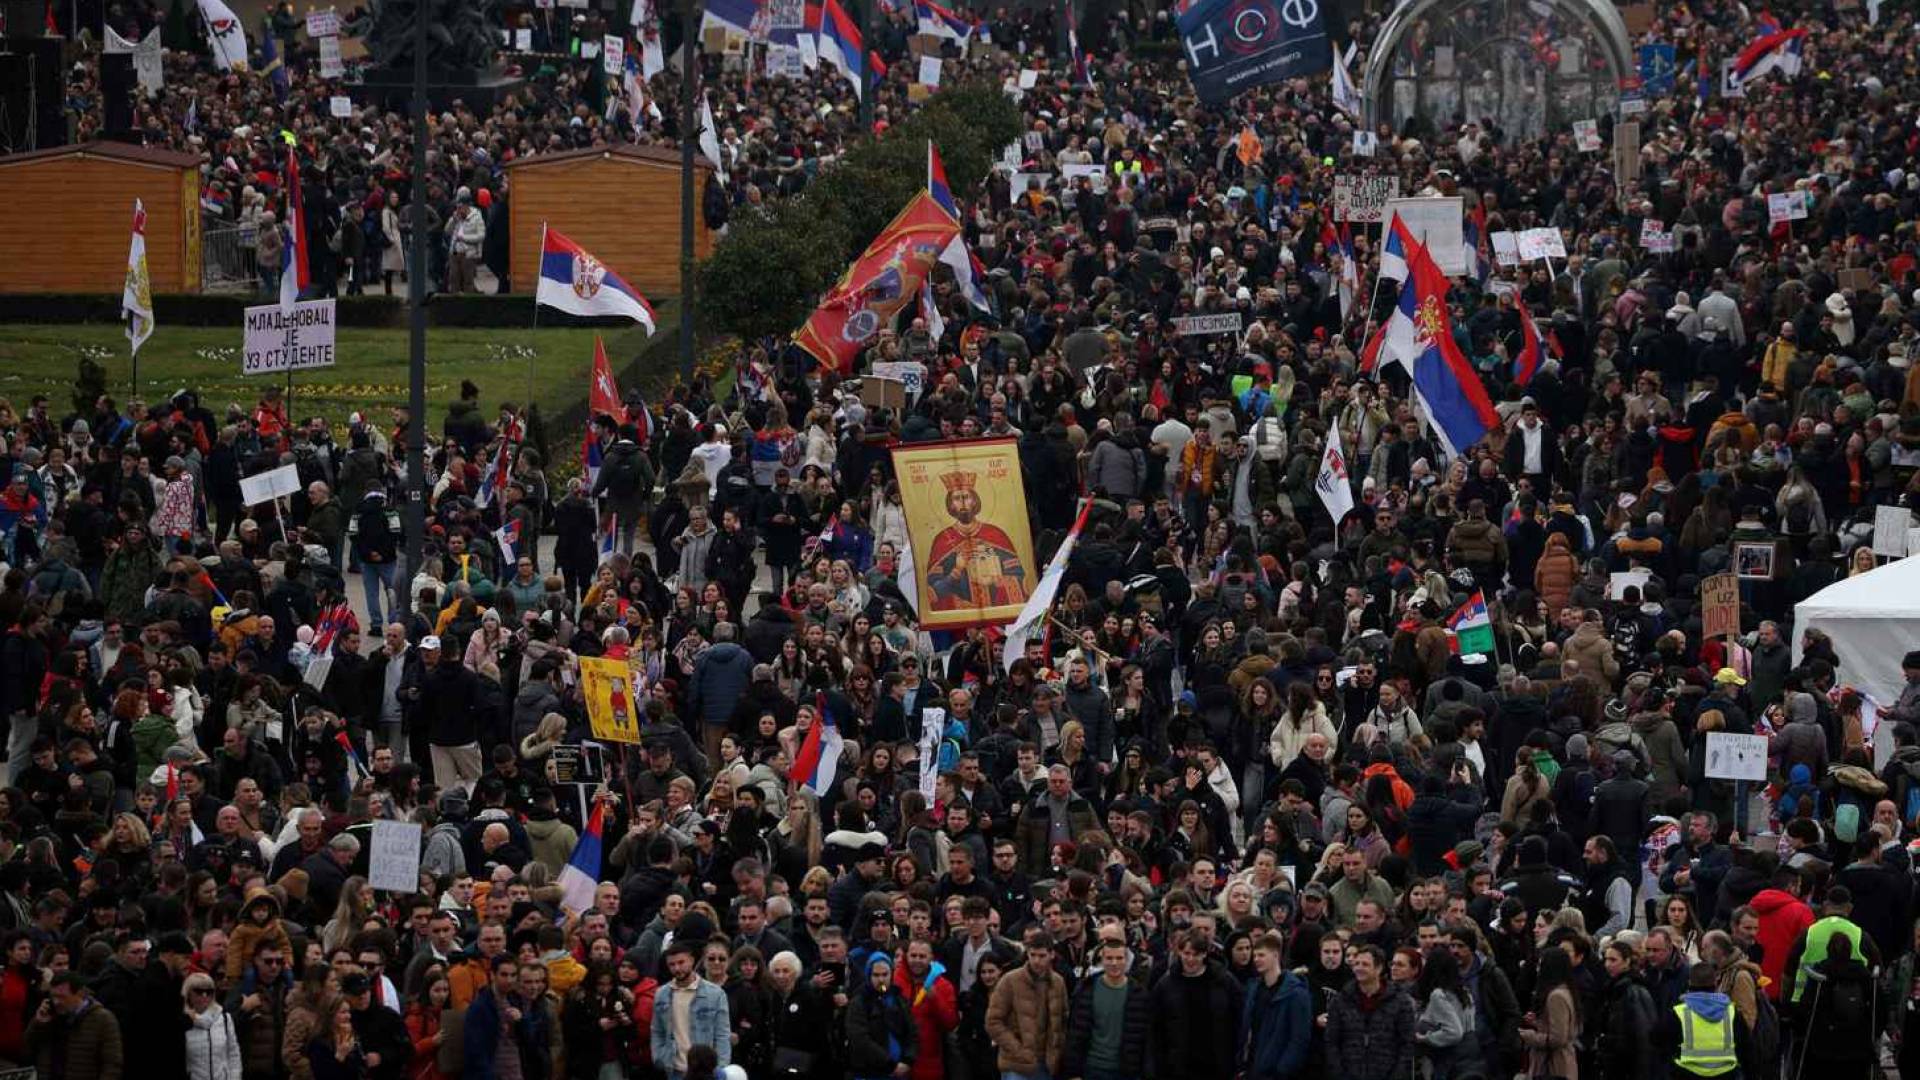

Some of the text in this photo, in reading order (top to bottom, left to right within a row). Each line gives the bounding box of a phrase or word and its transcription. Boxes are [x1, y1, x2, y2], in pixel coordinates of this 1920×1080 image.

[248, 307, 330, 331] МЛАДЕНОВАЦ
[282, 328, 299, 347] ЈЕ
[246, 344, 332, 369] УЗ СТУДЕНТЕ
